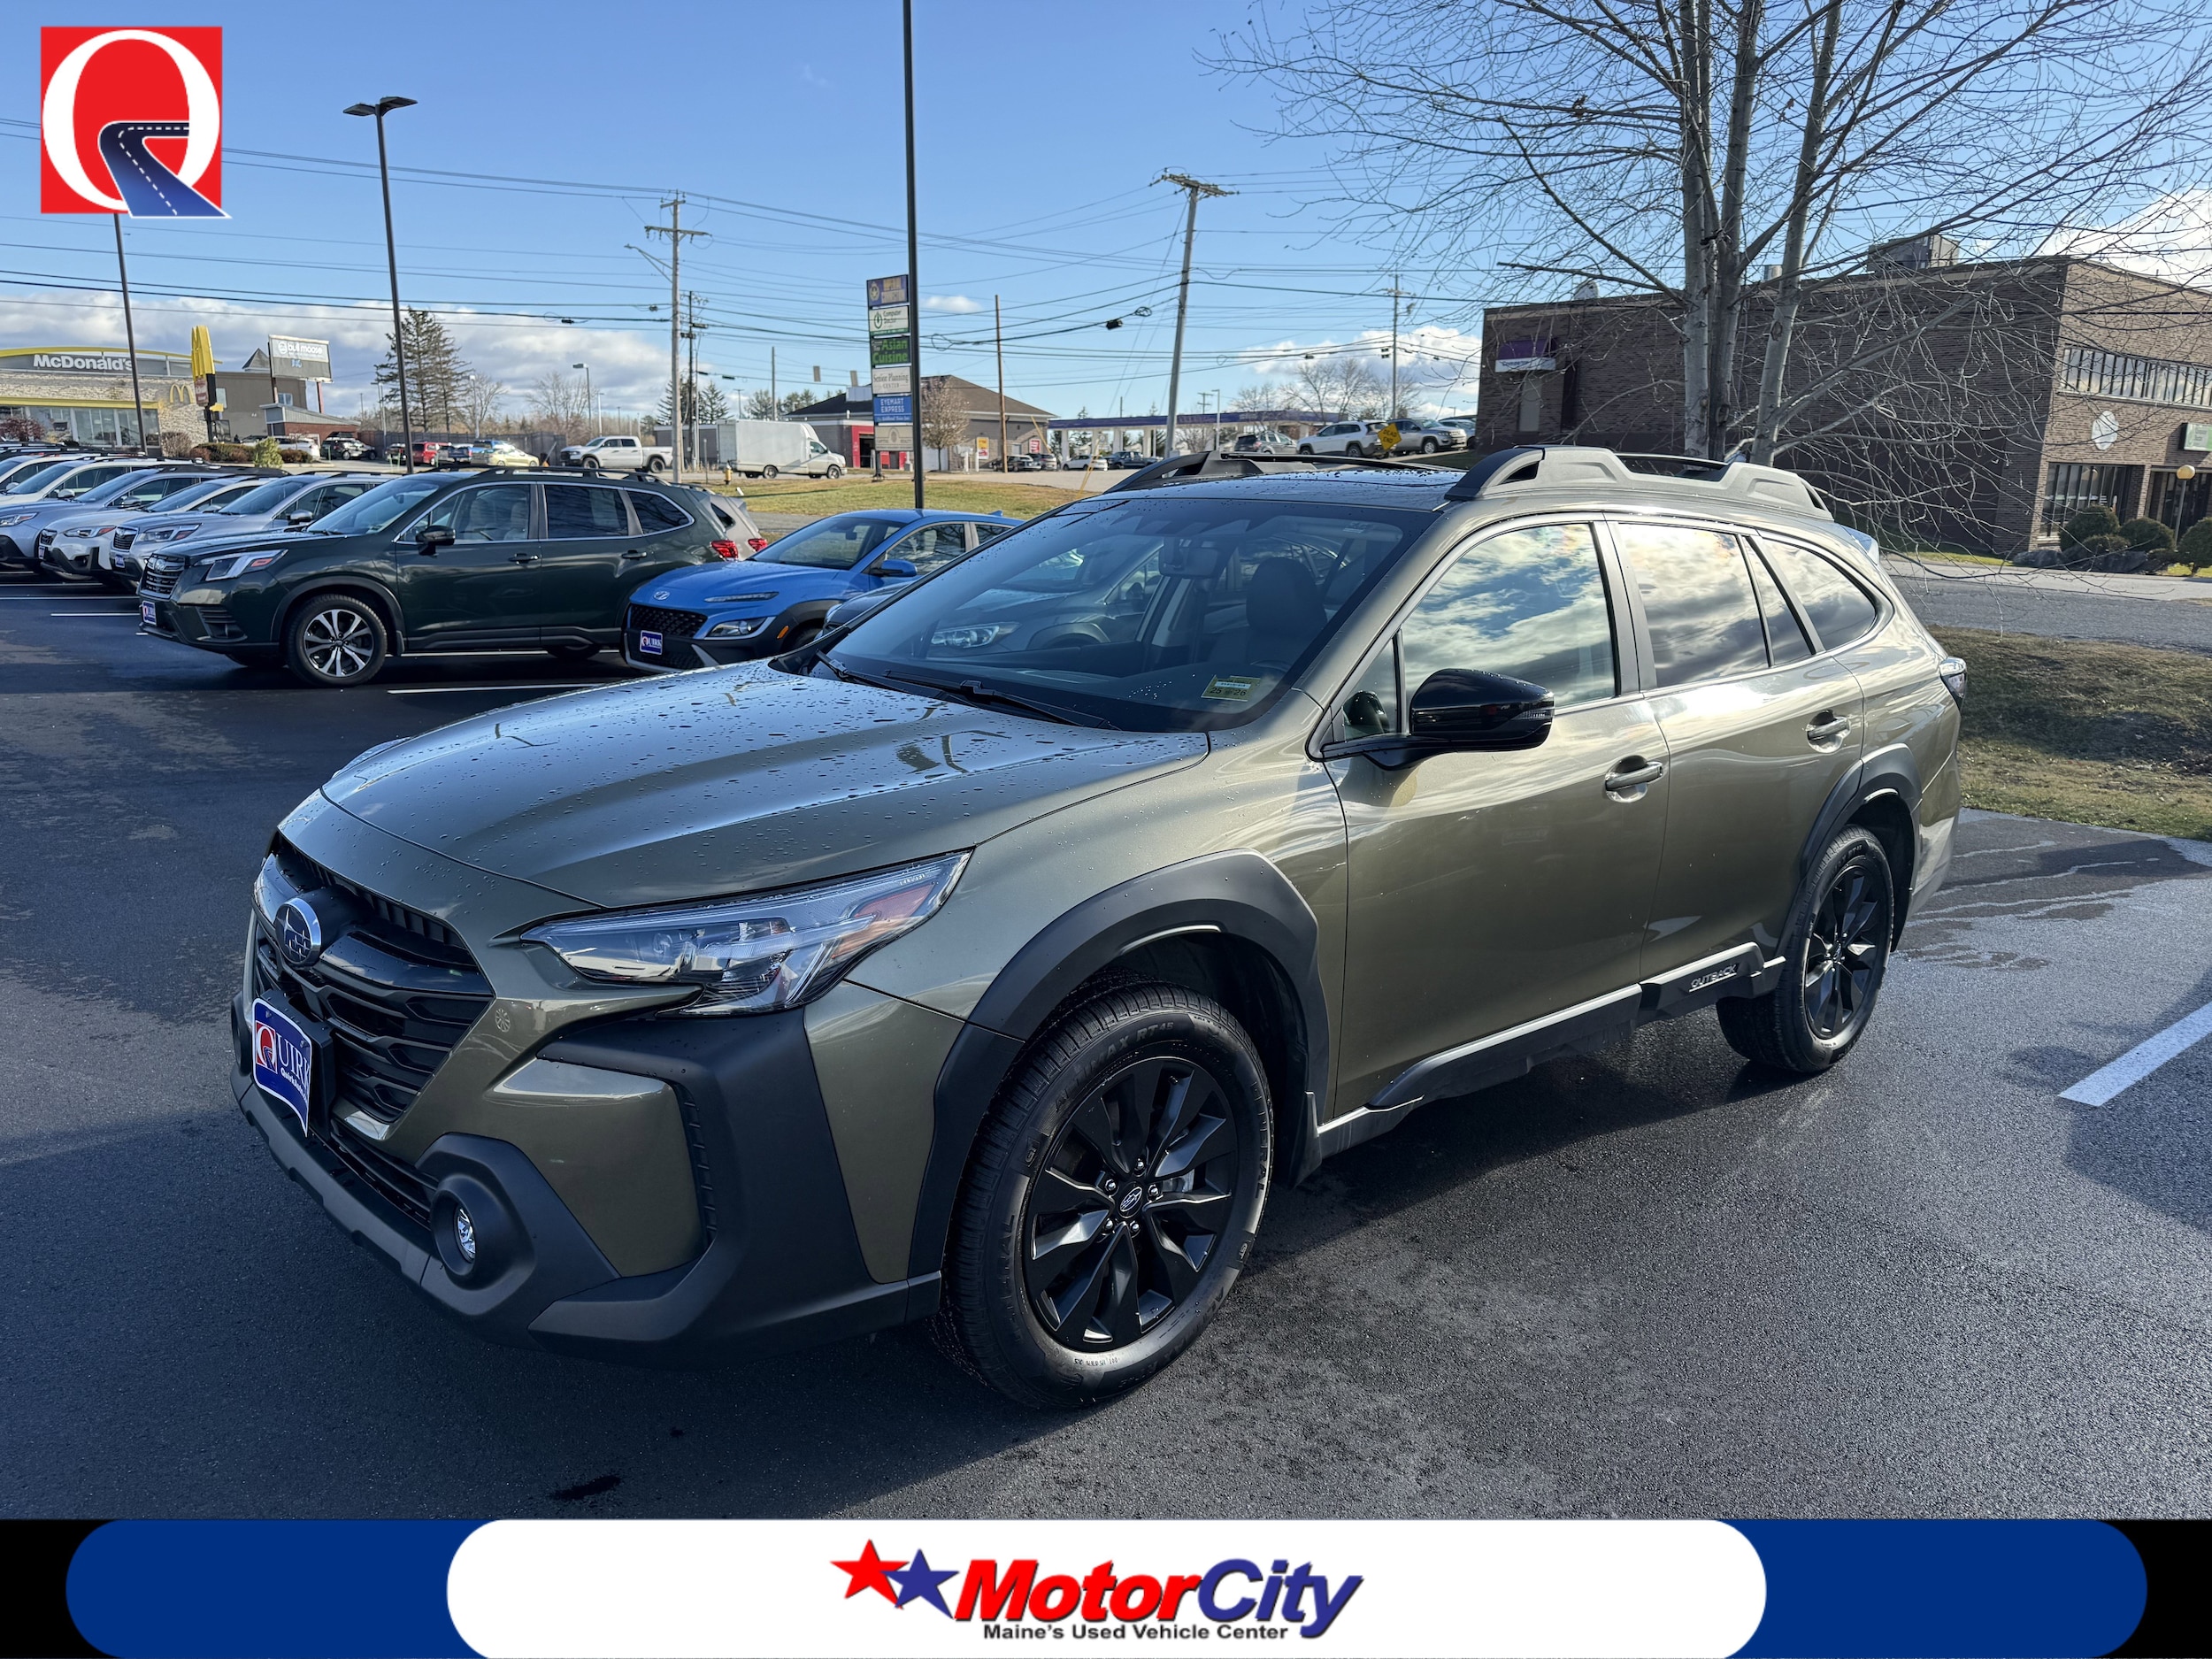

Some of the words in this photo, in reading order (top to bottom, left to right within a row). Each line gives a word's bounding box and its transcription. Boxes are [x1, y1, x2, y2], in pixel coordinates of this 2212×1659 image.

[882, 338, 908, 351] Asian
[33, 354, 133, 372] McDonald's
[872, 350, 908, 365] Cuisine
[880, 397, 904, 406] EYEMART
[1691, 964, 1737, 987] OUTBACK
[256, 1025, 310, 1087] QUIRK
